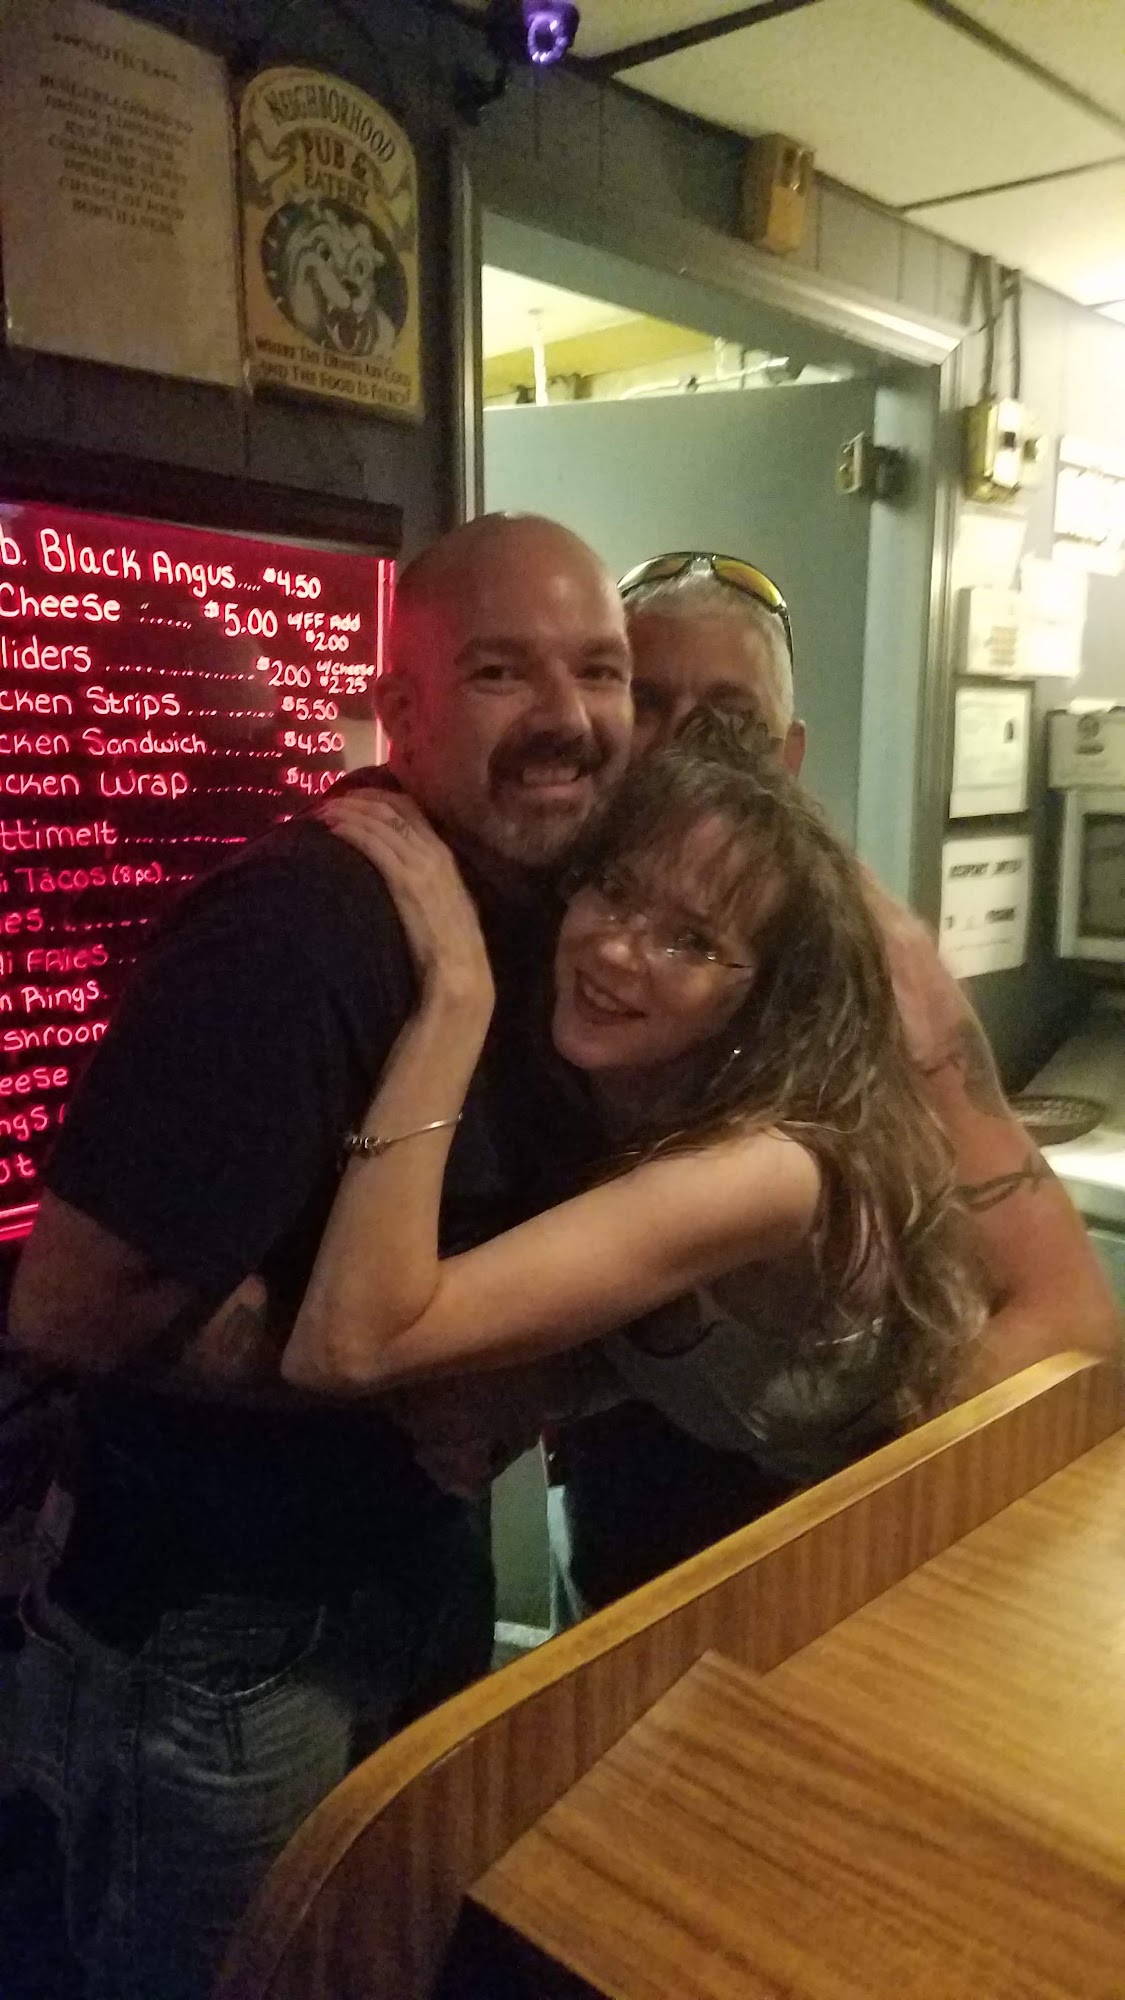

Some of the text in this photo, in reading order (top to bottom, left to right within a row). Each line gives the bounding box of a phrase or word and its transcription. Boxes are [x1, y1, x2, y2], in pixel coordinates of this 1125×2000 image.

[304, 134, 346, 170] PUB
[40, 528, 142, 581] Black
[263, 567, 321, 599] $4.50
[0, 582, 121, 622] Cheese
[204, 600, 278, 637] $5.00
[330, 613, 361, 632] Add
[86, 686, 181, 720] Strips
[281, 696, 338, 720] $5.50
[82, 727, 208, 756] Sandwich
[284, 731, 344, 755] $4.50
[100, 769, 188, 800] Wrap
